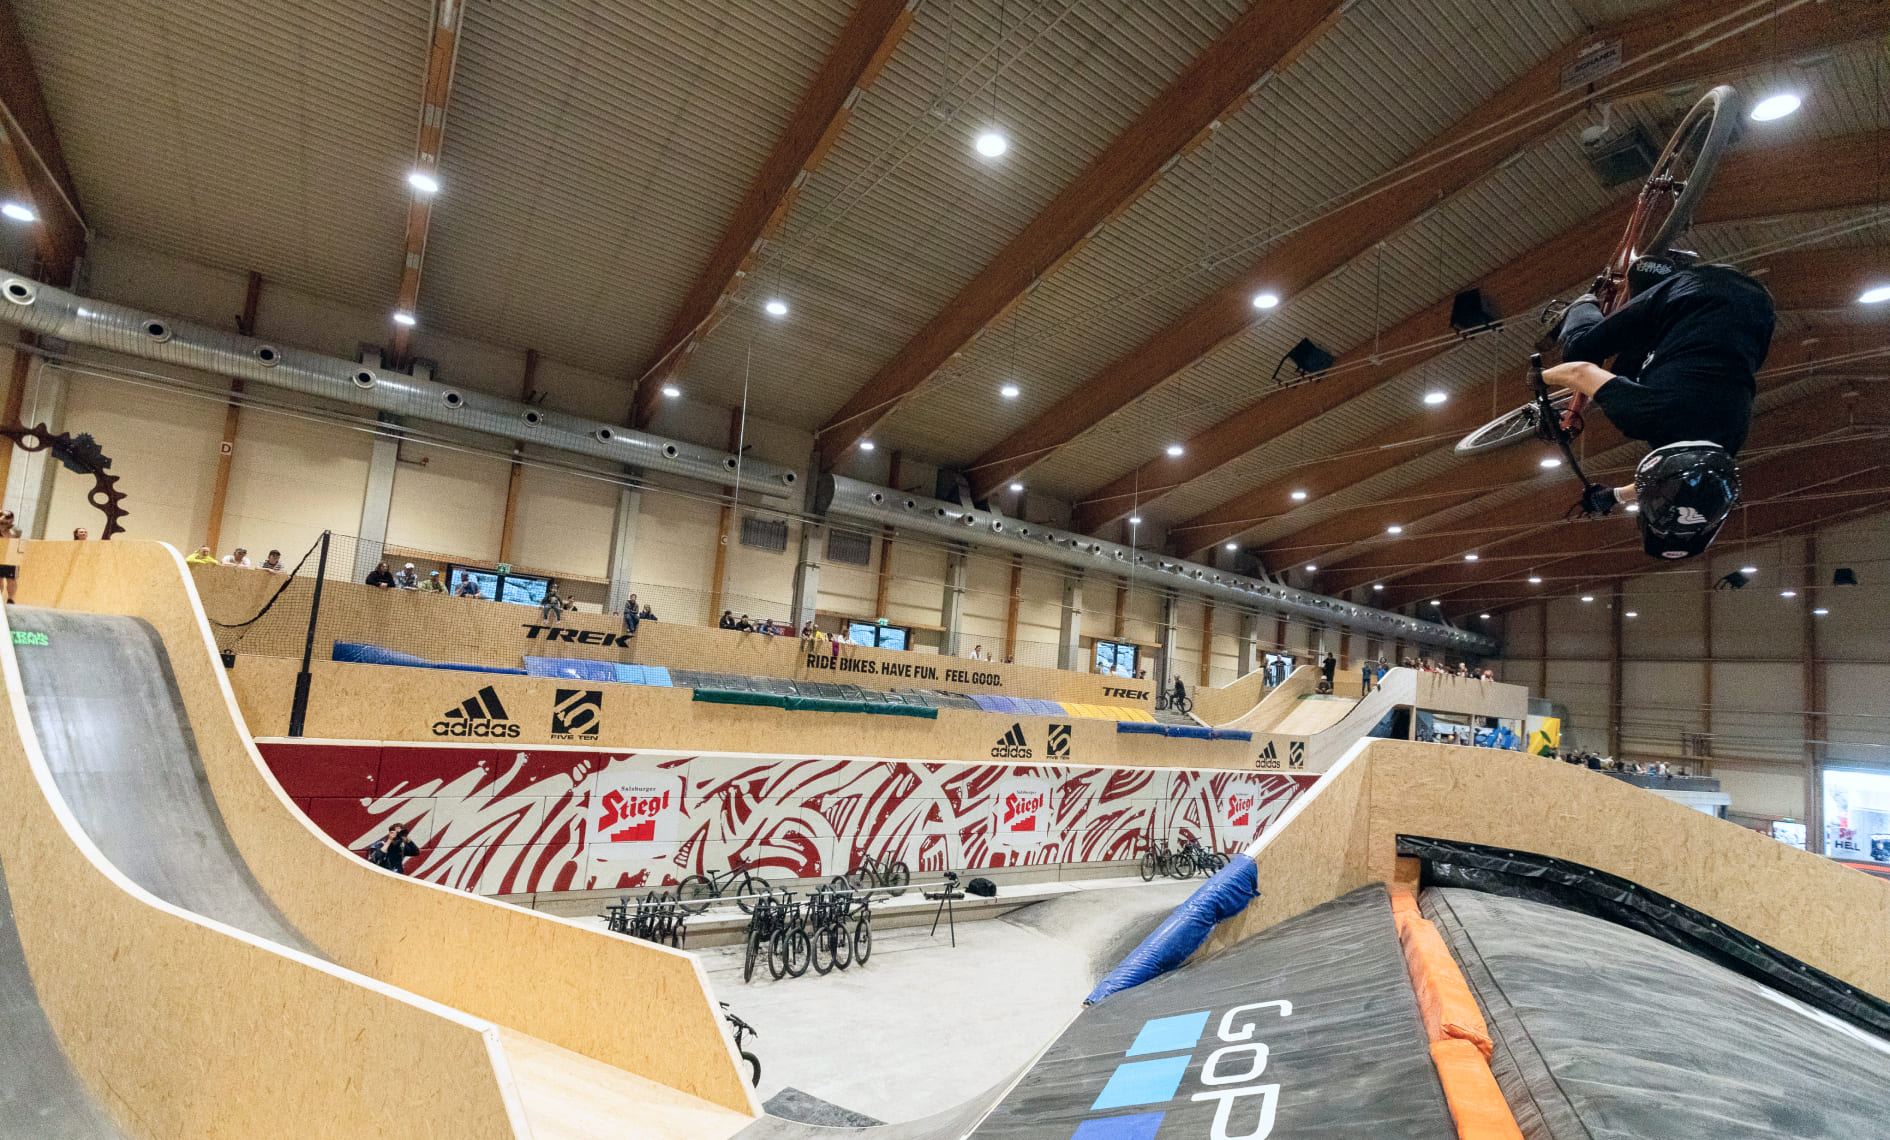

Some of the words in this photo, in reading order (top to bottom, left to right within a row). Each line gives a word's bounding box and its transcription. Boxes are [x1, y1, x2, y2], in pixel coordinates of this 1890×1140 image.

[522, 624, 634, 648] TREK
[807, 654, 836, 670] RIDE
[840, 657, 879, 675] BIKES.
[881, 662, 911, 678] HAVE
[914, 666, 939, 681] FUN.
[945, 669, 970, 684] FEEL
[972, 672, 1003, 687] GOOD.
[1102, 686, 1150, 700] TREK
[432, 718, 521, 738] adidas
[991, 746, 1033, 759] adidas
[1255, 758, 1281, 769] adidas
[598, 789, 670, 832] Stiegl
[1004, 792, 1044, 825] Stiegl
